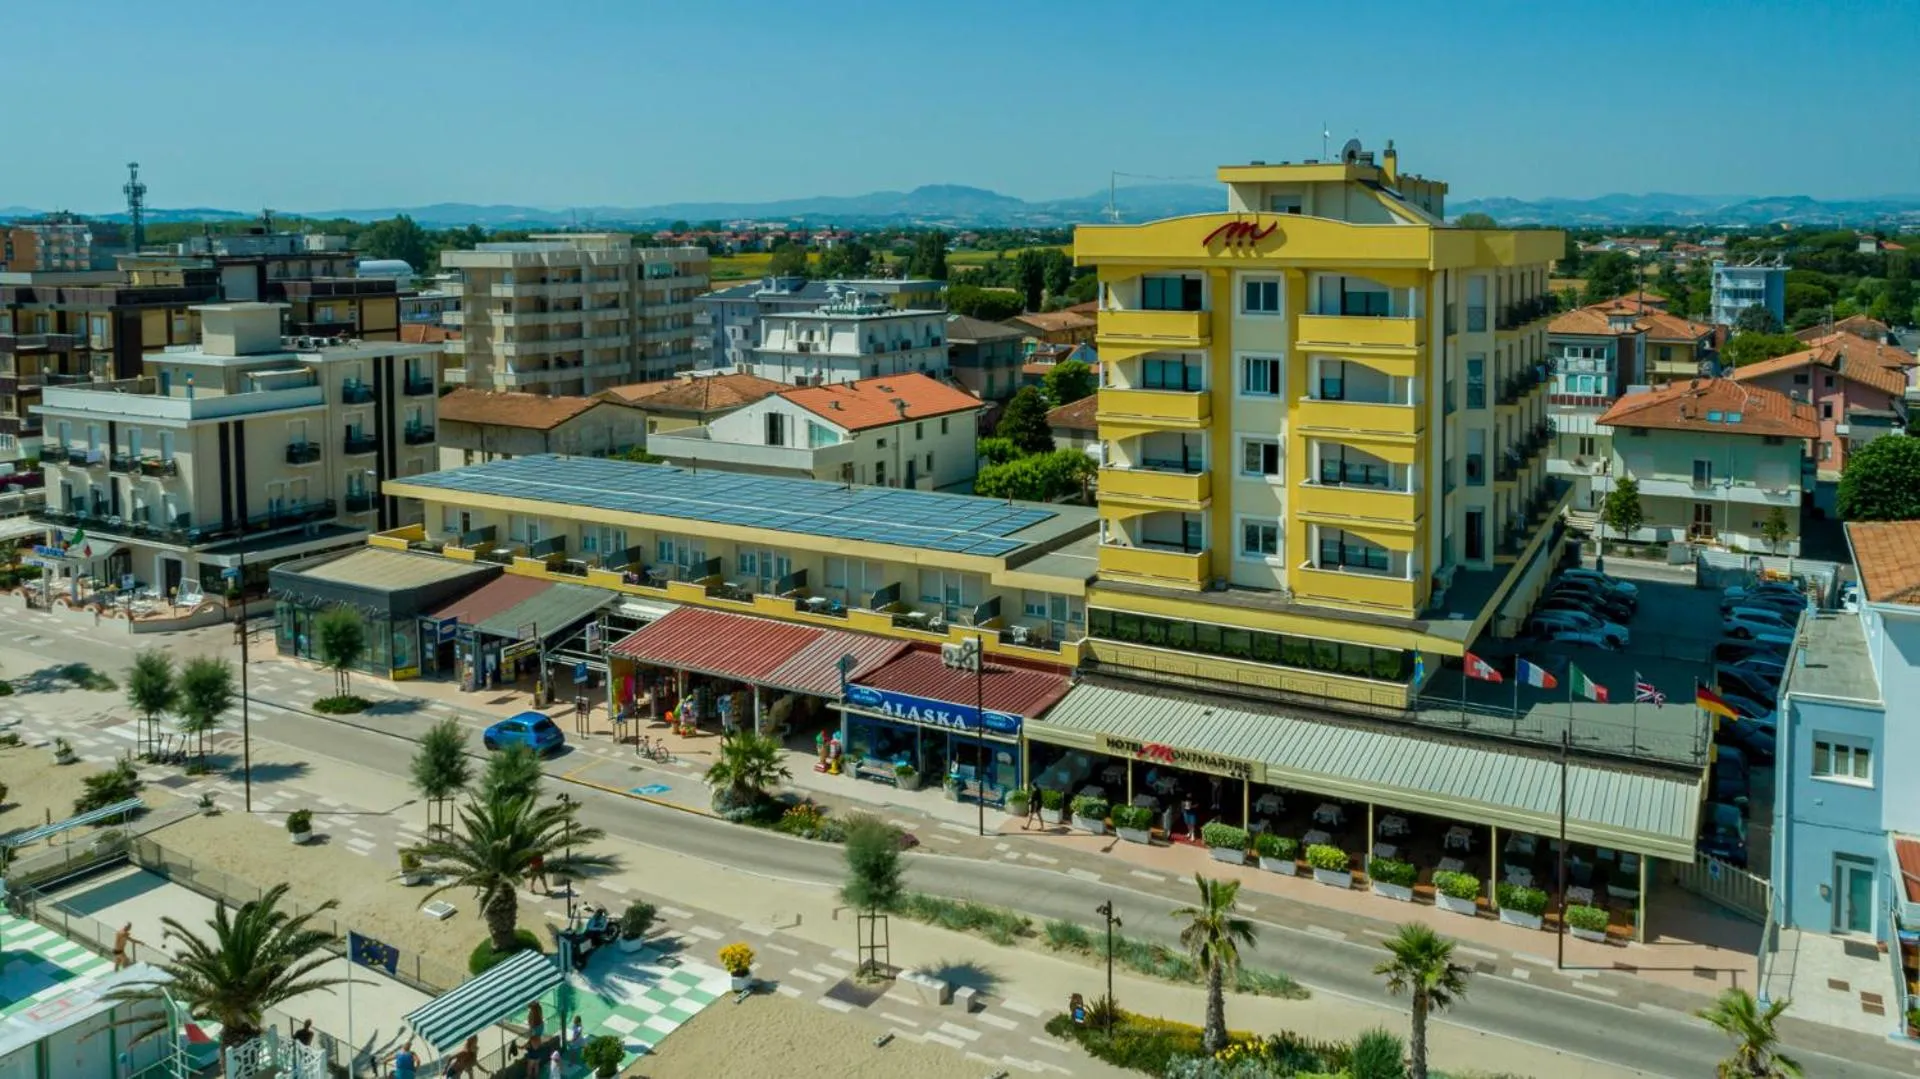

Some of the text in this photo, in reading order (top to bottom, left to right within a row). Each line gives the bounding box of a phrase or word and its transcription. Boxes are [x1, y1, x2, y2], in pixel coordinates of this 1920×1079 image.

[882, 700, 967, 730] ALASKA
[1106, 737, 1252, 774] HOTEL MONTMARTRE
